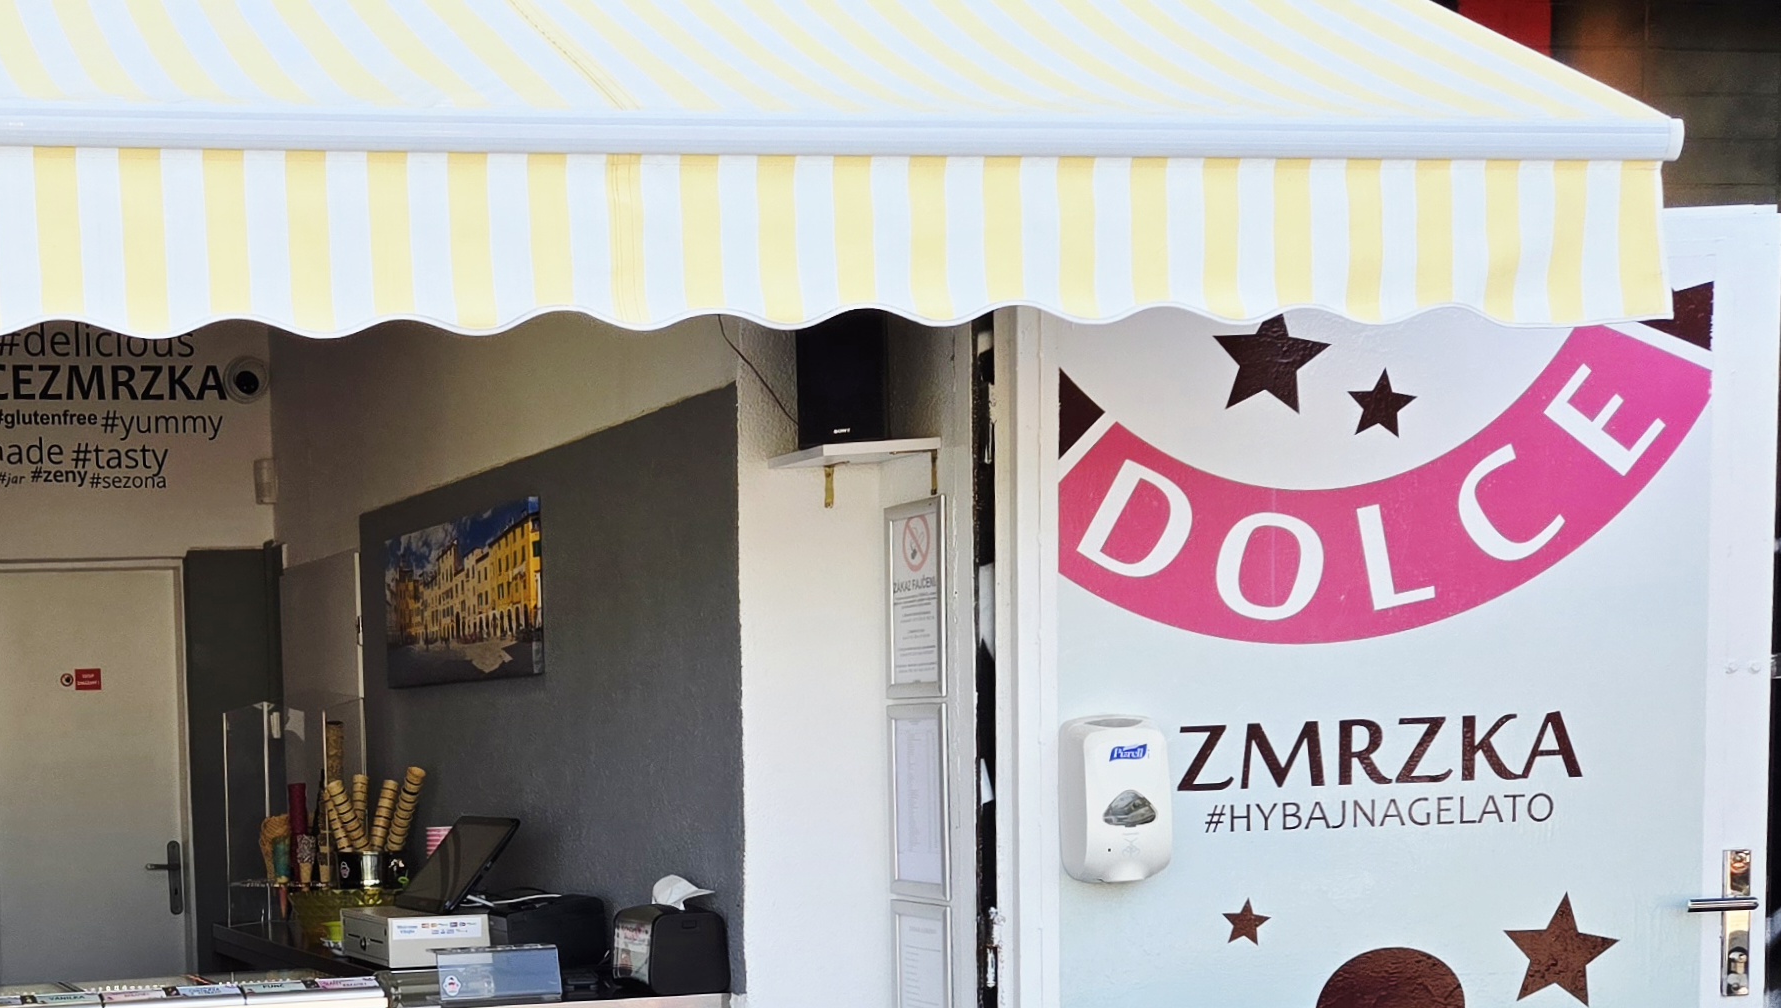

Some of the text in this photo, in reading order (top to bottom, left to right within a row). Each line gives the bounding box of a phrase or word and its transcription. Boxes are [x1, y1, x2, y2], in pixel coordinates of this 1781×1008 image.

[101, 410, 223, 441] #yummy
[30, 466, 88, 487] #zeny
[90, 472, 167, 489] #sezona
[71, 442, 169, 477] #tasty
[1075, 362, 1666, 621] DOLCE
[1176, 711, 1583, 792] ZMRZKA
[1204, 793, 1555, 833] #HYBAJNAGELATO
